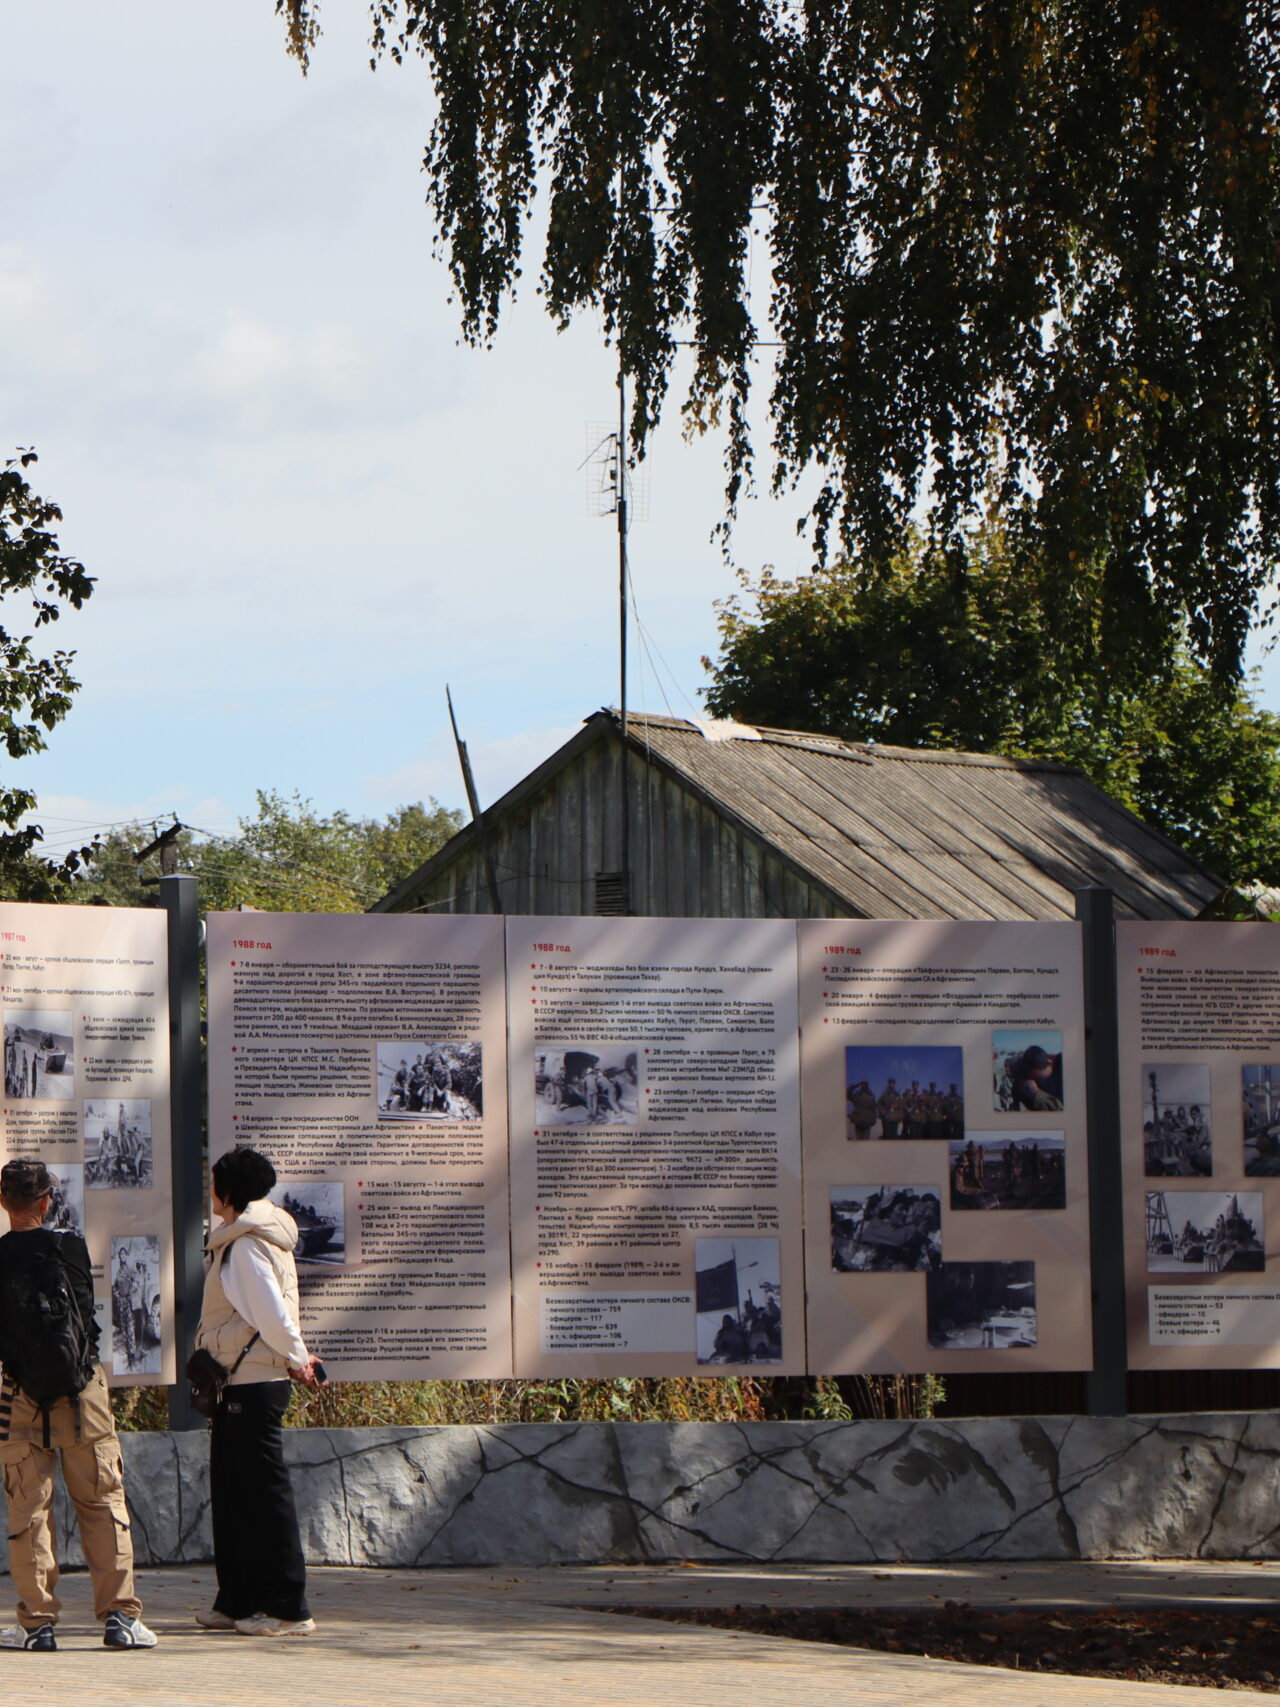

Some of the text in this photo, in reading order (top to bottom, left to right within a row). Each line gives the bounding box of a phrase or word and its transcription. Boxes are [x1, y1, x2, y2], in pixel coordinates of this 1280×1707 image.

[1, 932, 25, 942] 1987 год
[232, 940, 254, 948] 1988
[532, 943, 554, 951] 1988
[824, 945, 861, 955] 1989 год
[1139, 947, 1160, 955] 1989
